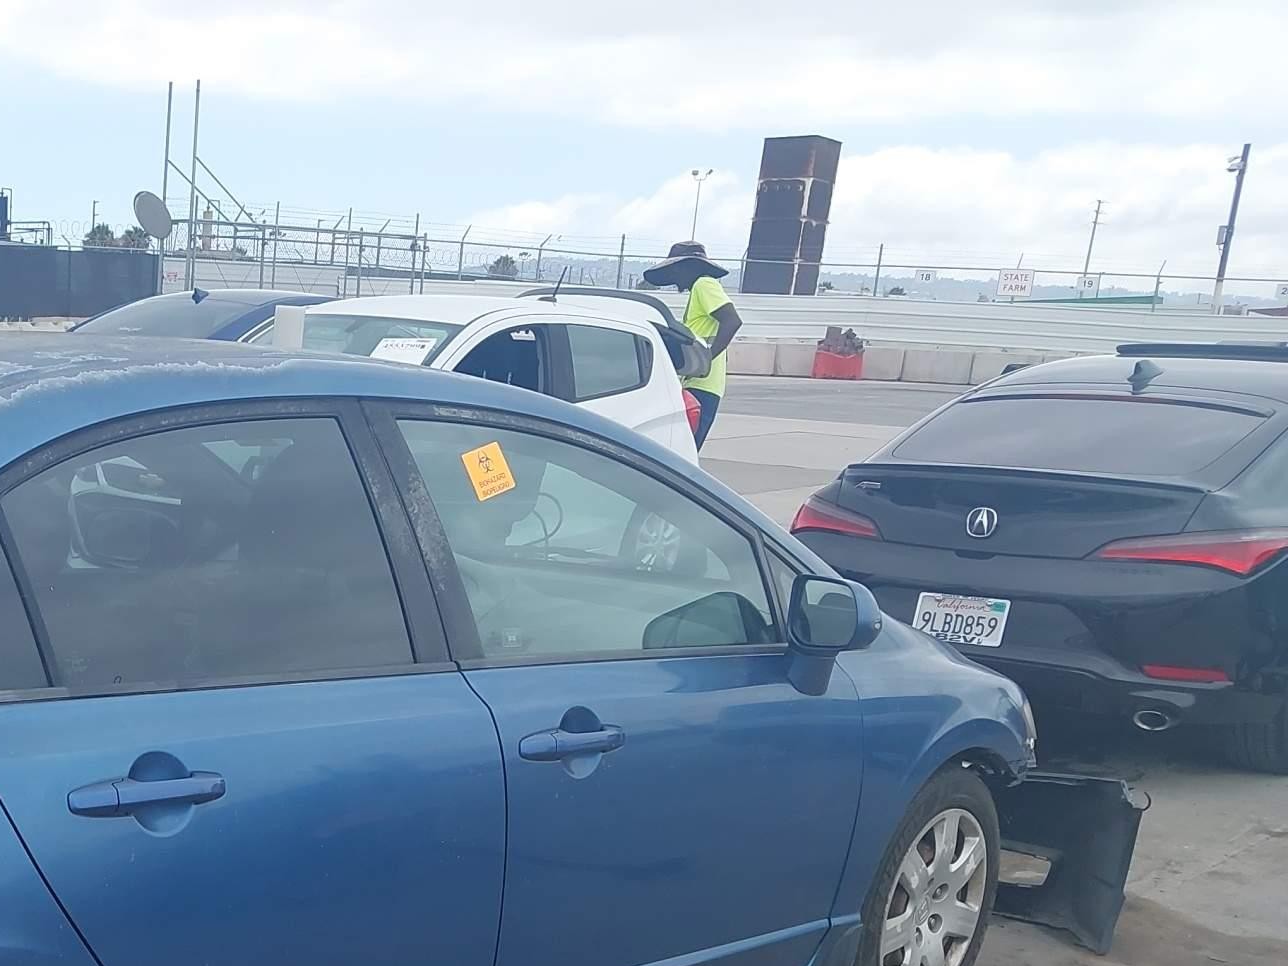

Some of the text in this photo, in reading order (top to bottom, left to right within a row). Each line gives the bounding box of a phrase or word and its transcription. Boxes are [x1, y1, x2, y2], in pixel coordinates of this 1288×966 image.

[920, 273, 931, 281] 18
[1003, 273, 1030, 282] STATE
[1002, 283, 1027, 292] FARM
[1082, 280, 1094, 288] 19
[936, 600, 991, 613] California
[919, 611, 999, 637] 9LBD859
